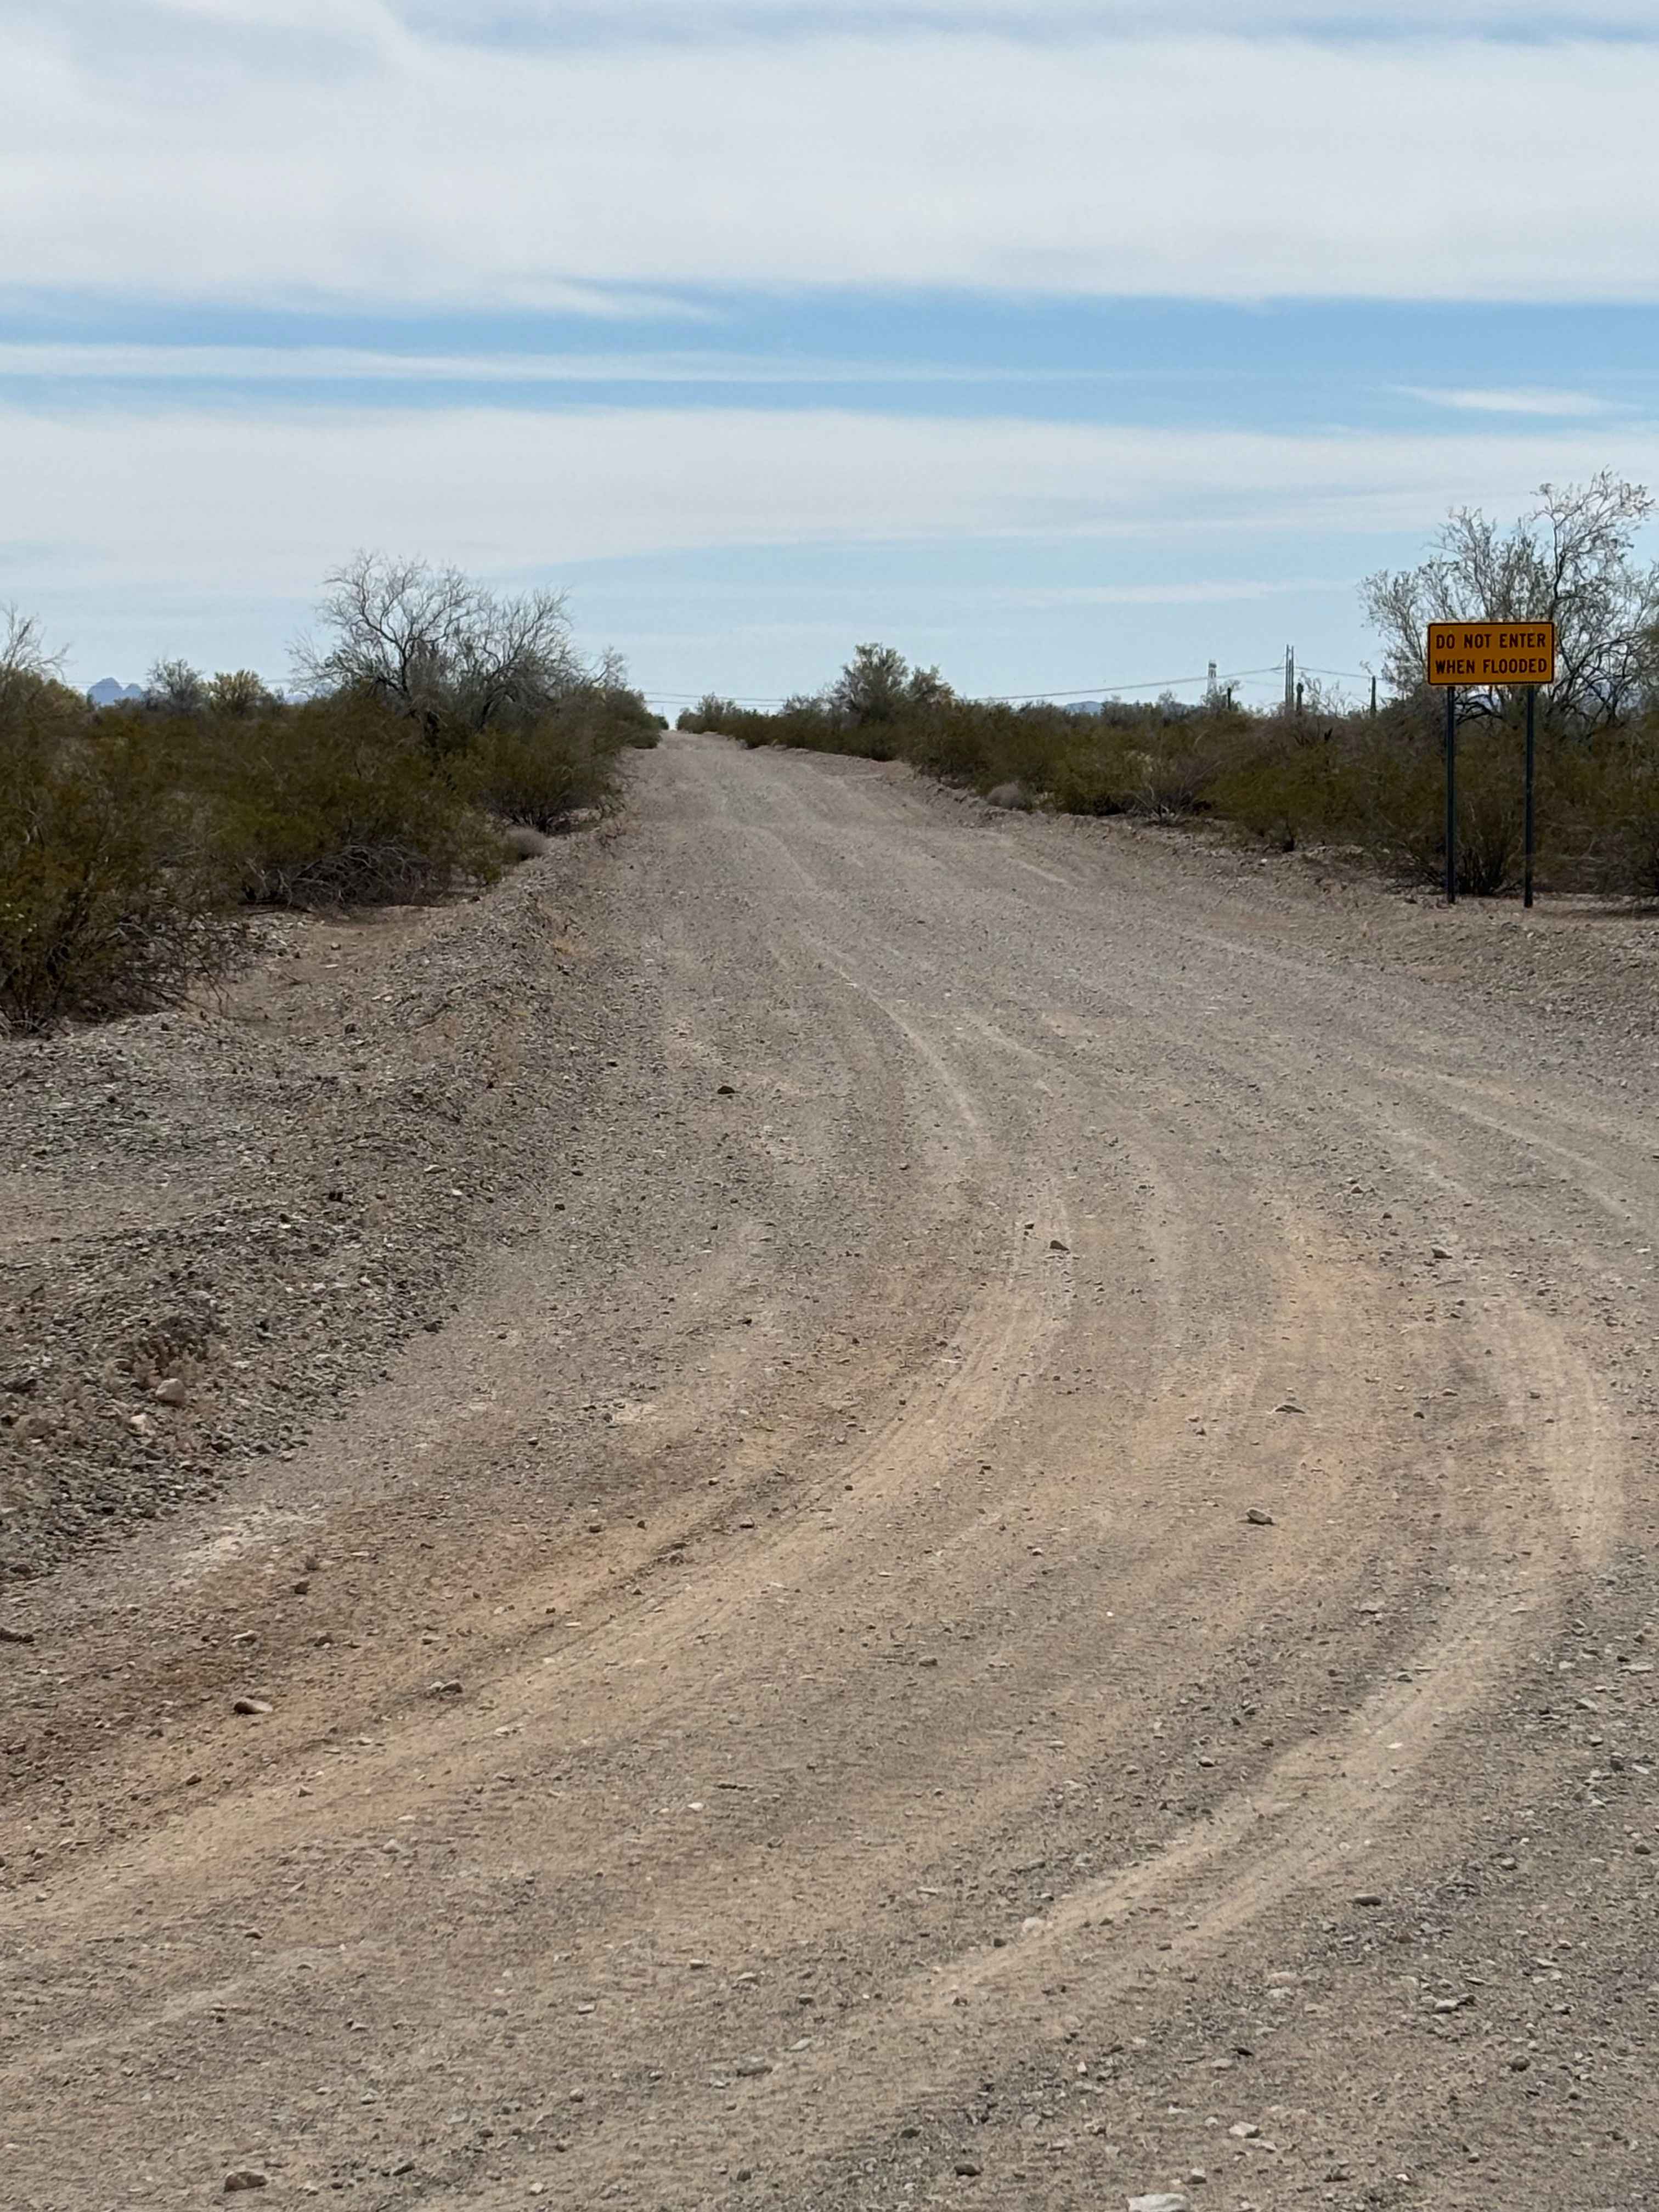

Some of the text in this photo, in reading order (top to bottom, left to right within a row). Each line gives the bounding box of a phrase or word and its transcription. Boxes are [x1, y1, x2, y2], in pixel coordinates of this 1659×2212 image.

[1436, 633, 1545, 649] DO NOT ENTER
[1435, 658, 1547, 674] WHEN FLOODED
